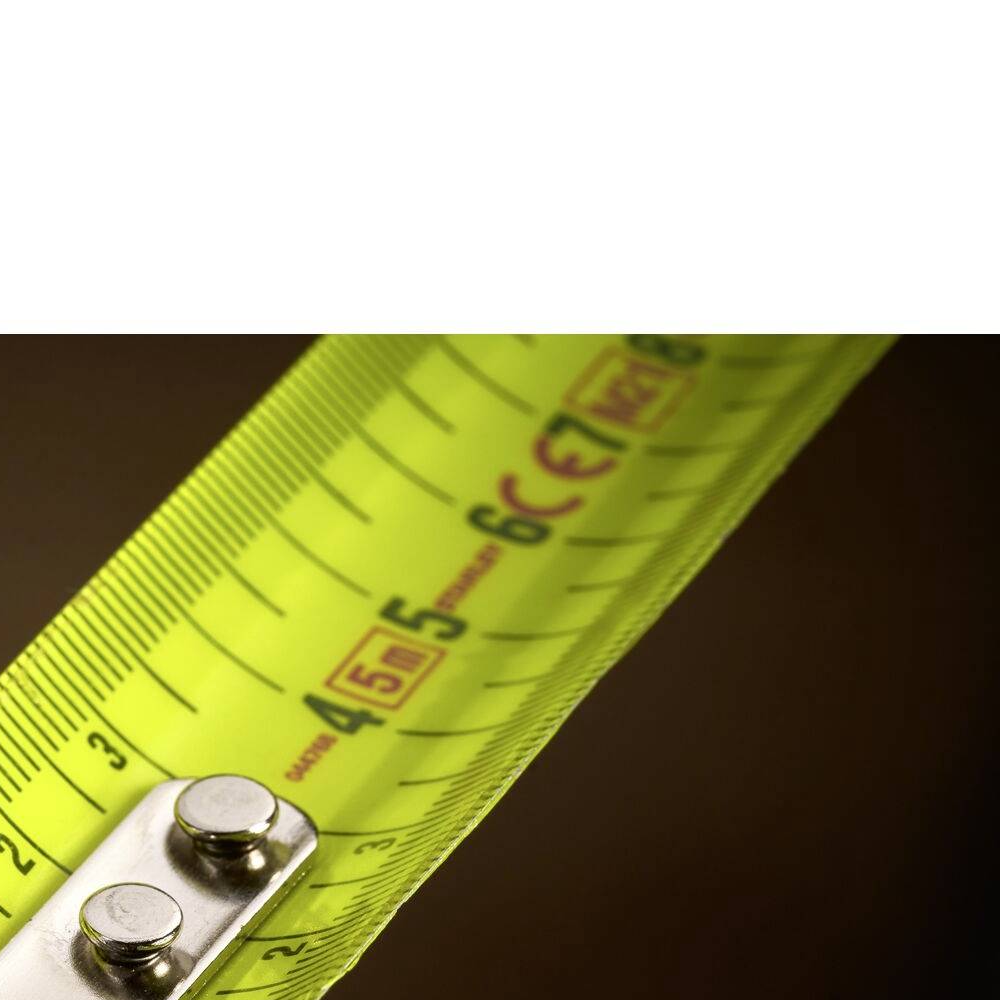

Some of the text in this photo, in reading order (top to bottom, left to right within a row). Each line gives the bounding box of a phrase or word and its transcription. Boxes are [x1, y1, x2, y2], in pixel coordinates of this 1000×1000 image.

[547, 412, 628, 451] 7
[467, 504, 552, 546] 6
[380, 597, 468, 640] 5
[347, 645, 427, 694] 5m
[303, 693, 386, 735] 4
[87, 731, 128, 771] 3
[353, 837, 397, 855] 3
[262, 941, 309, 961] 2
